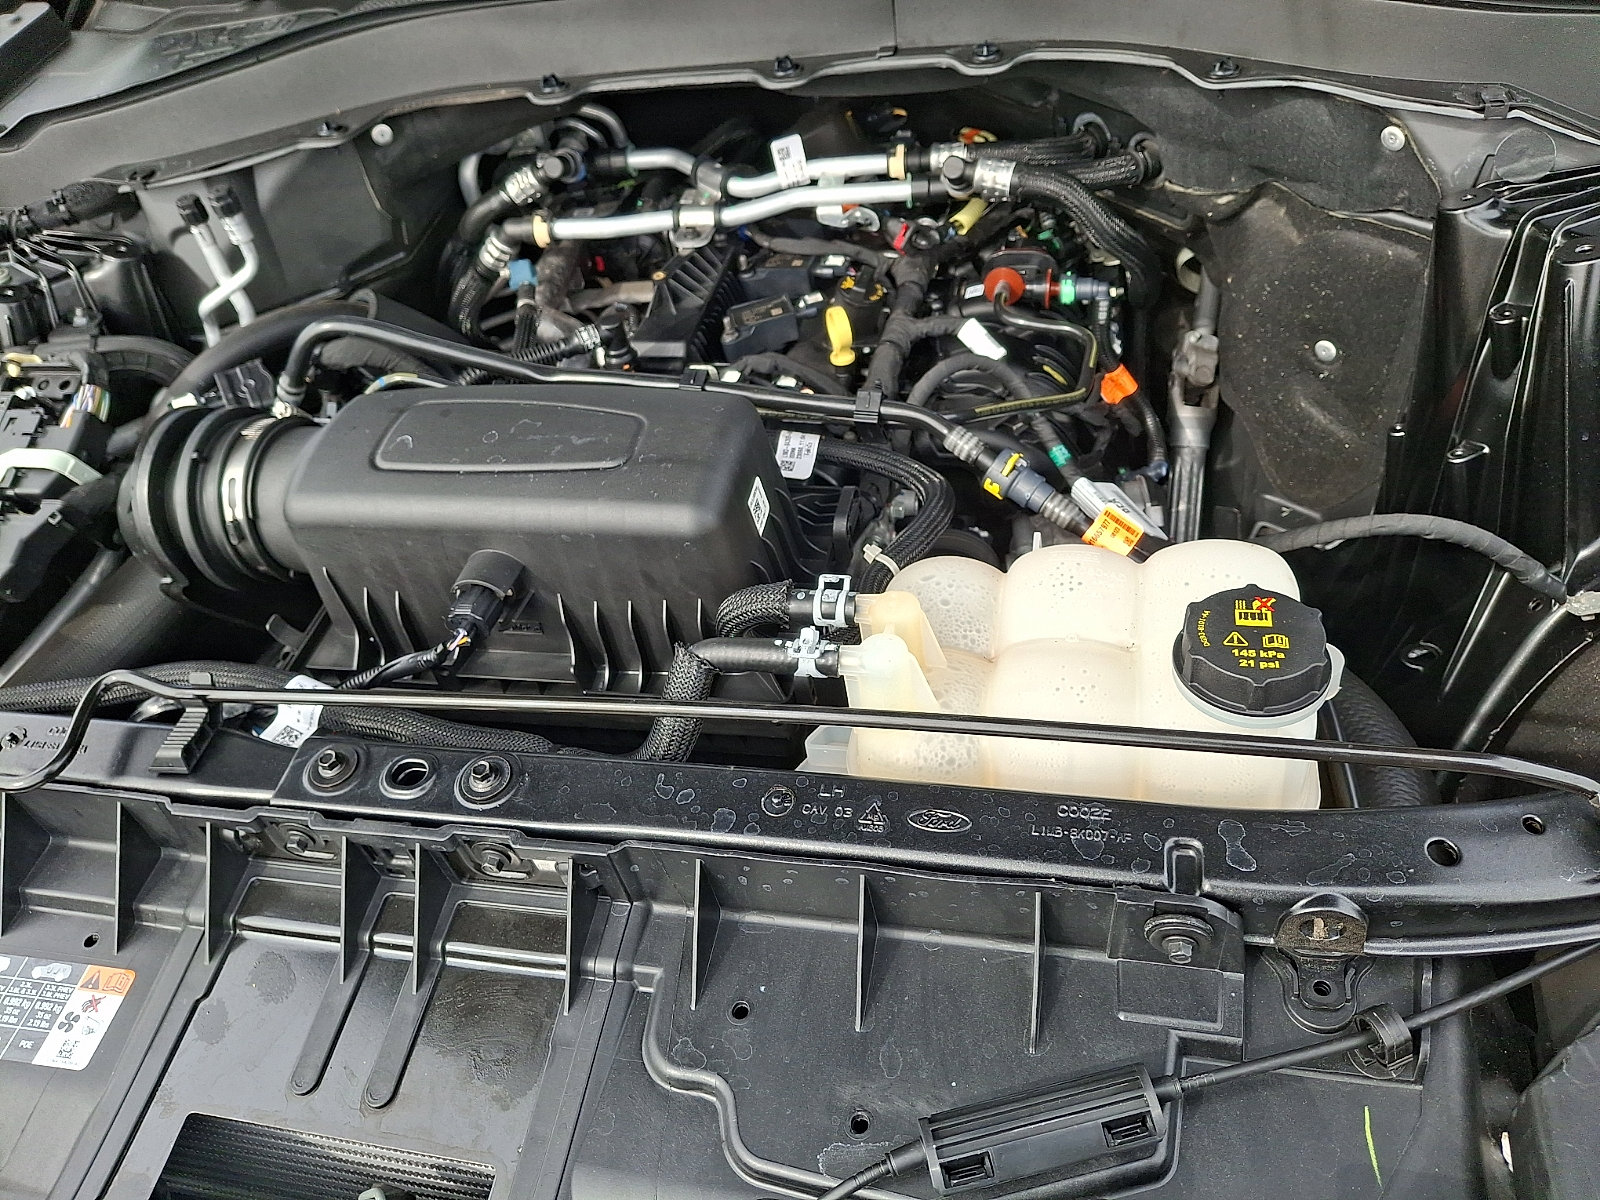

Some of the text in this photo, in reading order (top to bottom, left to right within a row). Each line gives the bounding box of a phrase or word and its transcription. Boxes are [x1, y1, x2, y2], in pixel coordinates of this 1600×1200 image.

[1231, 648, 1286, 659] 145 kPa
[1239, 659, 1280, 670] 21 psi
[801, 804, 854, 818] CAV 03
[916, 811, 962, 830] Ford
[19, 1040, 34, 1049] POE
